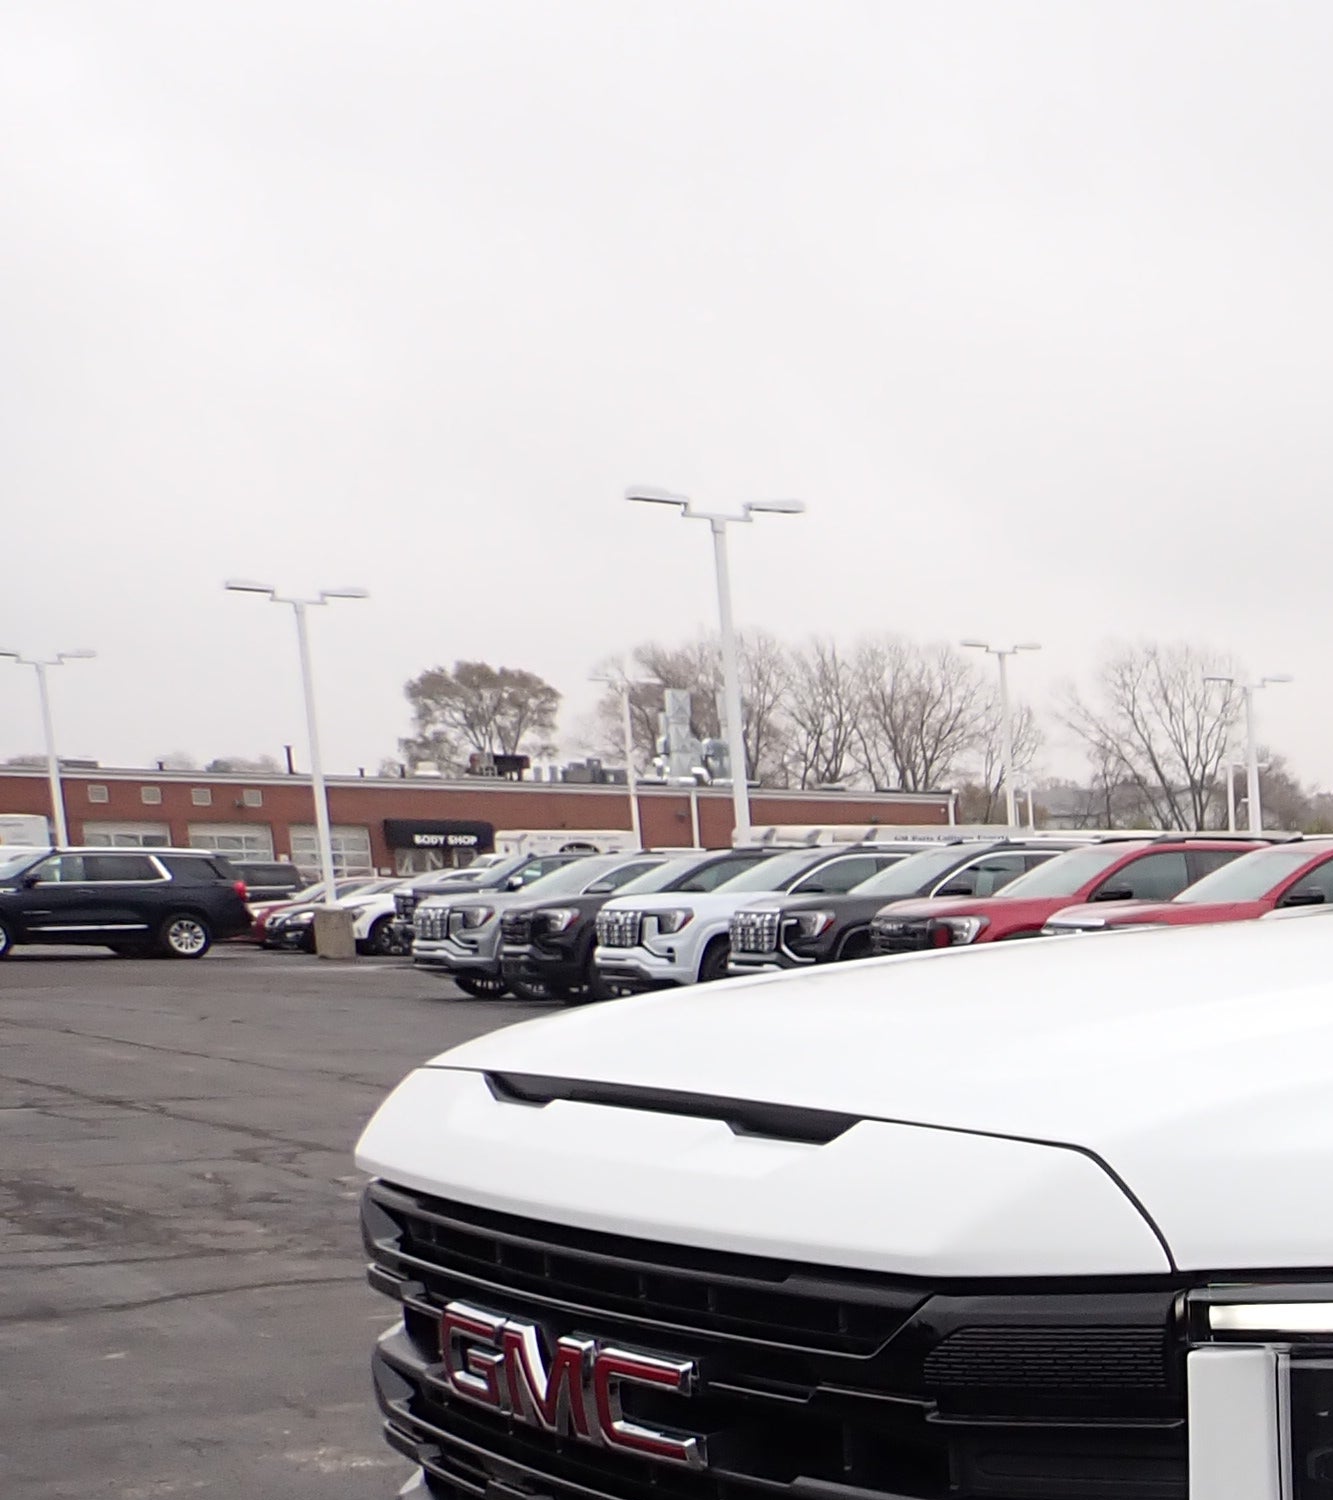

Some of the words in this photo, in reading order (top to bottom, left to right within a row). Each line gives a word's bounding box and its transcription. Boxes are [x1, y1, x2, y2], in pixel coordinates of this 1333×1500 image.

[413, 834, 445, 845] BODY
[447, 834, 478, 845] SHOP
[442, 1300, 708, 1467] GMC
